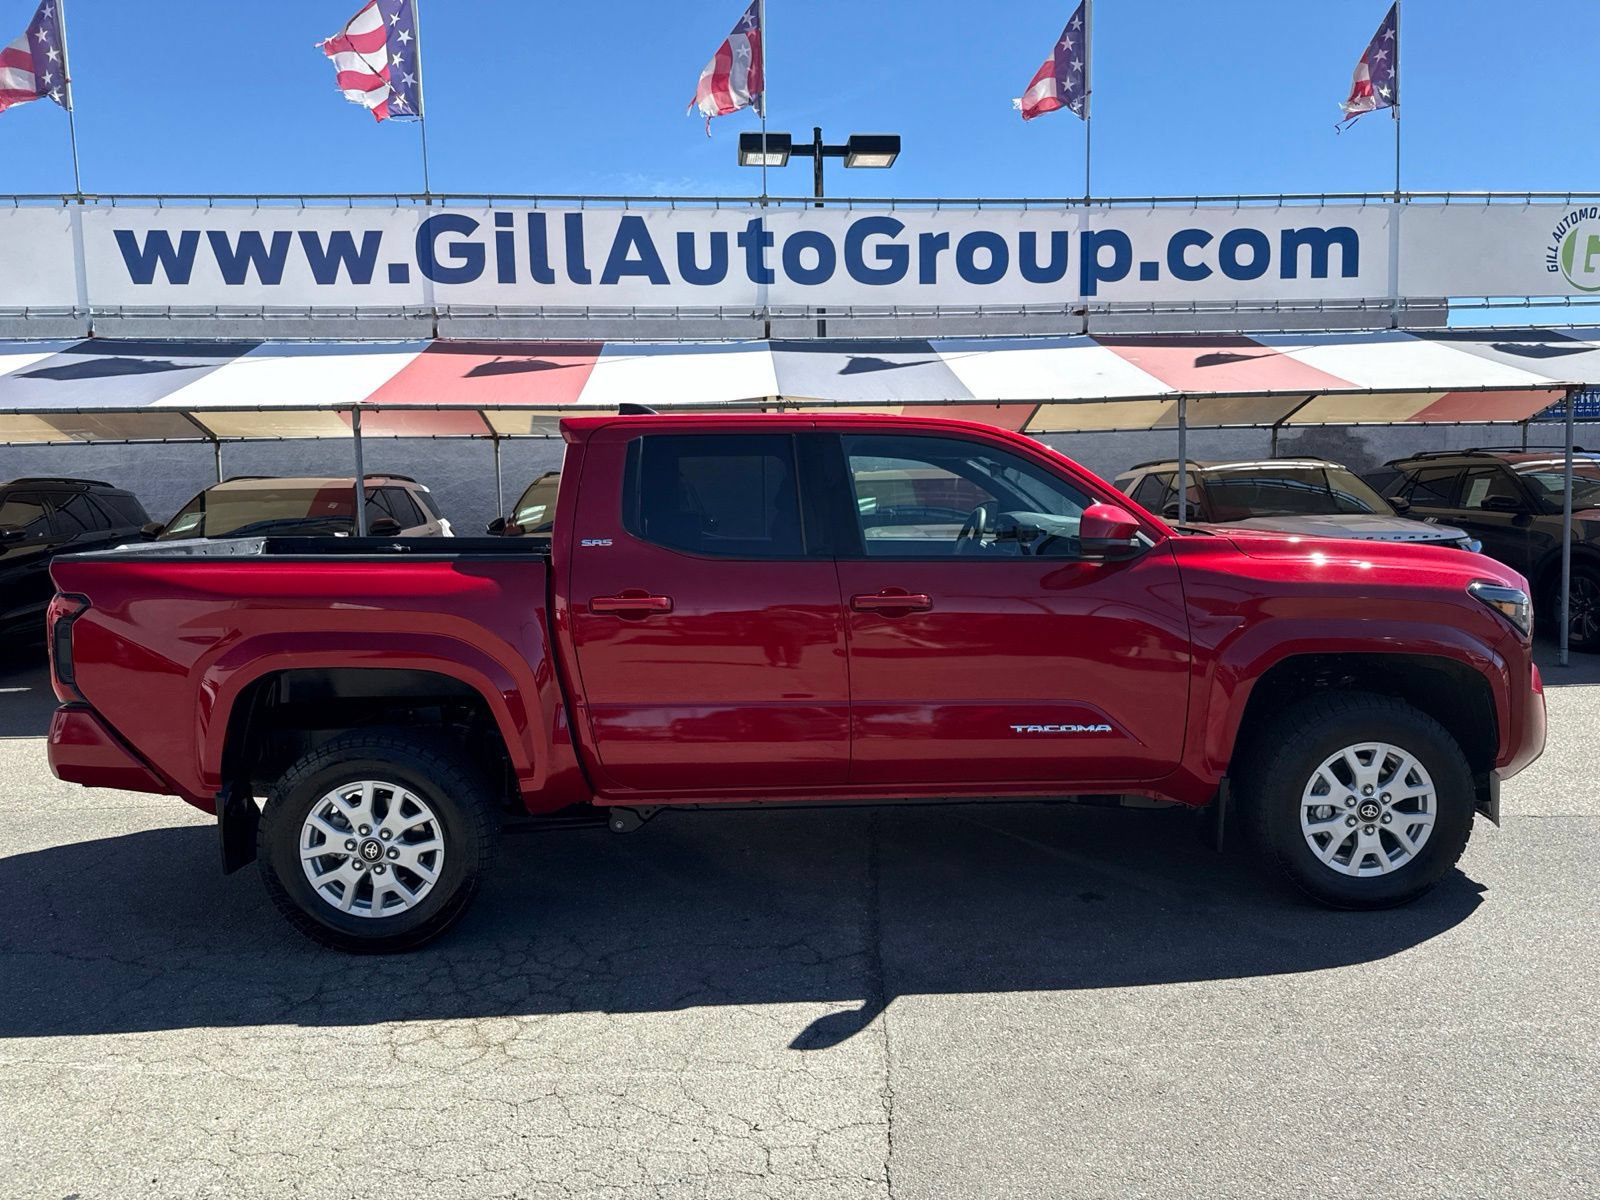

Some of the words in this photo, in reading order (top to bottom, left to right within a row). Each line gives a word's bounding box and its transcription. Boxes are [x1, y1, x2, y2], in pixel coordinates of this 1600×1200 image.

[1552, 207, 1600, 243] AUTOMO
[114, 212, 1359, 297] www.GillAutoGroup.com
[1546, 246, 1559, 272] GILL
[1010, 724, 1112, 733] TACOMA
